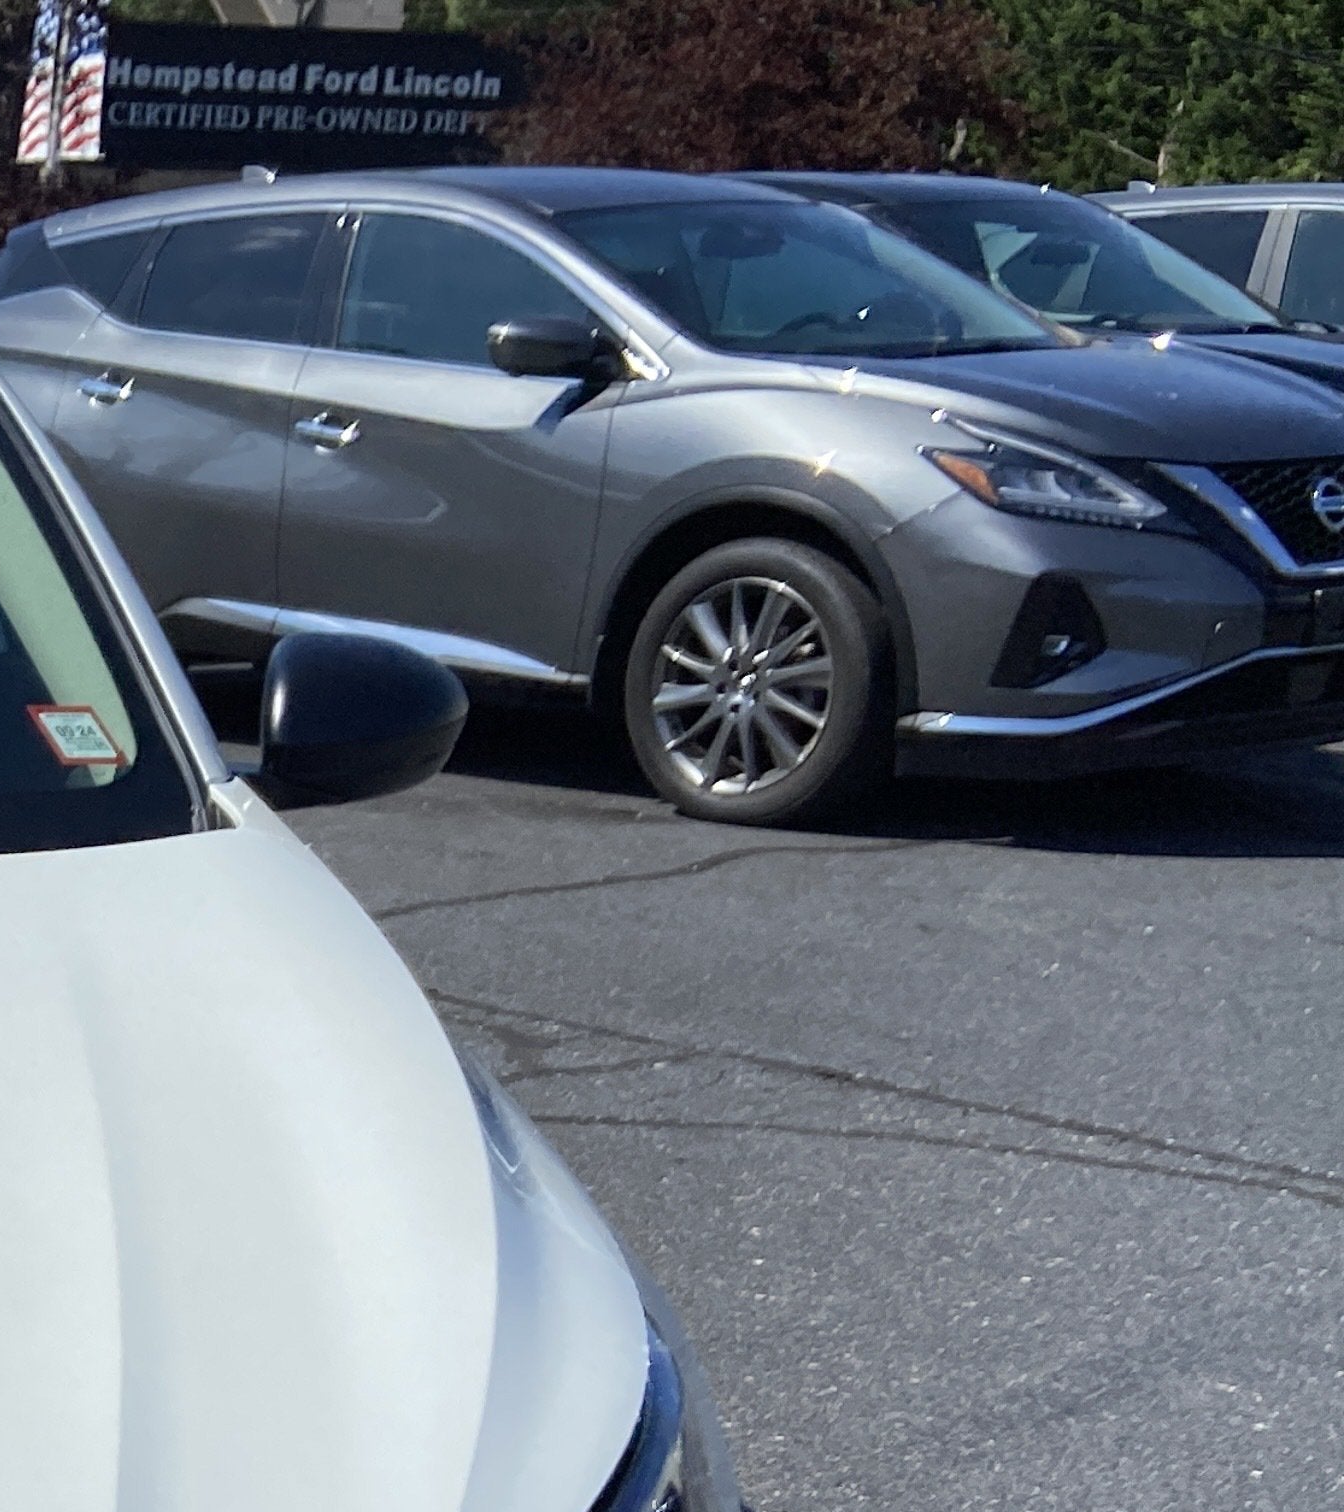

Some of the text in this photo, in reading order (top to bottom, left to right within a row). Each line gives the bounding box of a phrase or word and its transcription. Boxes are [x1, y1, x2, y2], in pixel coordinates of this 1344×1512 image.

[108, 56, 501, 98] Hempstead Ford Lincoln
[108, 101, 251, 131] CERTIFIED
[255, 104, 417, 134] PRE-OWNED
